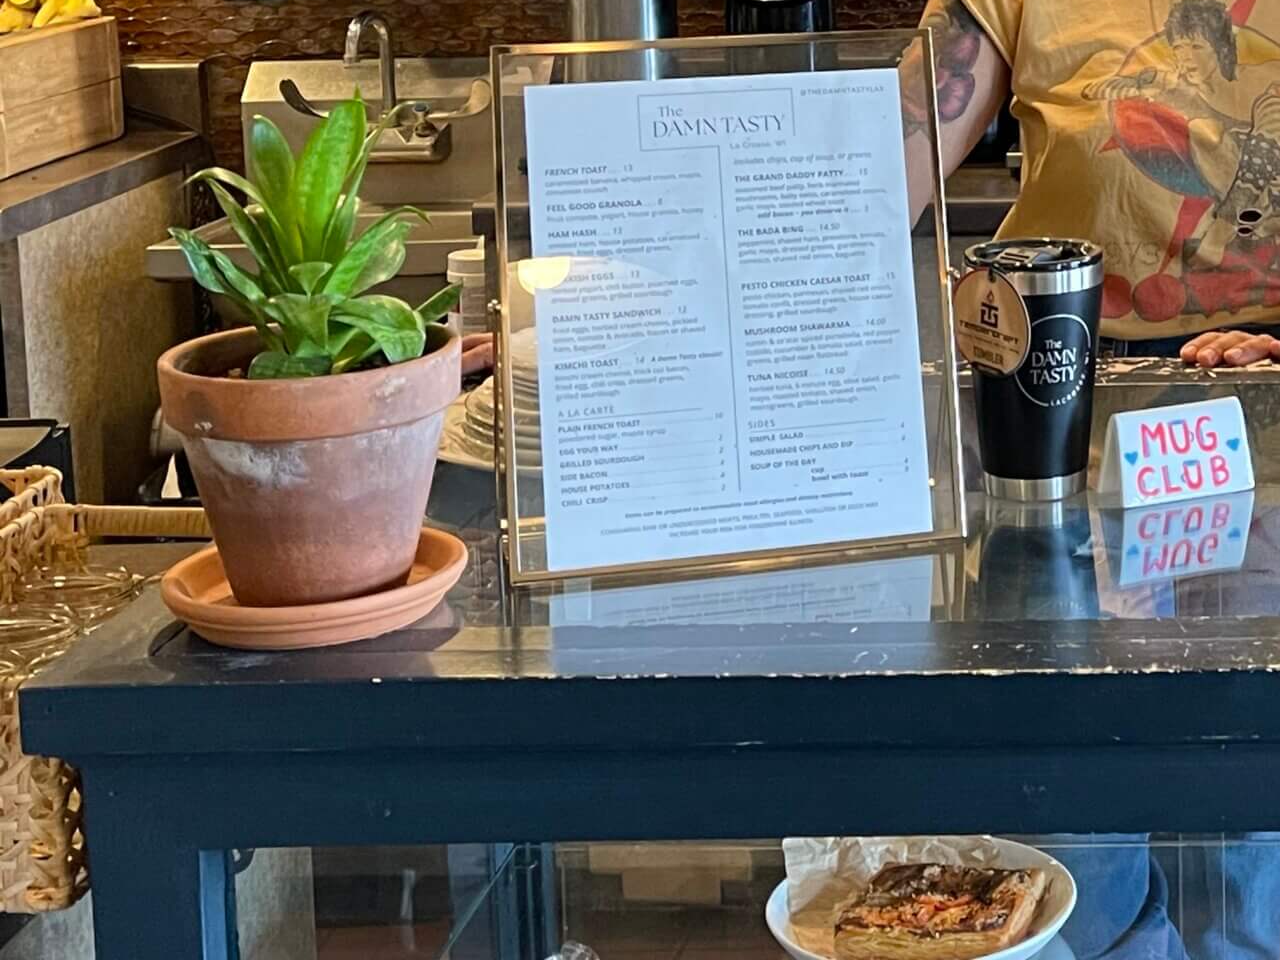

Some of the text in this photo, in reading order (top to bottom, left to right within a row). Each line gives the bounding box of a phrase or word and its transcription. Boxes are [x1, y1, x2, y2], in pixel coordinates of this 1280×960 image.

[656, 104, 684, 118] The
[652, 113, 785, 138] DAMN TASTY
[544, 167, 578, 176] FRENCH
[581, 165, 607, 174] TOAST
[734, 174, 750, 183] THE
[752, 172, 783, 182] GRAND
[785, 170, 815, 180] DADDY
[817, 169, 844, 178] PATTY
[546, 203, 566, 212] FEEL
[568, 202, 596, 210] GOOD
[598, 199, 642, 209] GRANOLA
[547, 228, 596, 239] HAM HASH
[737, 228, 753, 236] THE
[755, 226, 780, 235] BADA
[782, 225, 804, 233] BING
[591, 272, 614, 281] EGGS
[740, 281, 768, 290] PESTO
[769, 278, 807, 288] CHICKEN
[809, 275, 841, 285] CAESAR
[843, 273, 870, 283] TOAST
[551, 313, 581, 323] DAMN
[583, 311, 610, 320] TASTY
[612, 307, 661, 318] SANDWICH
[744, 324, 797, 335] MUSHROOM
[799, 320, 850, 331] SHAWARMA
[1044, 339, 1063, 349] The
[1031, 347, 1077, 367] DAMN
[553, 360, 588, 370] KIMCHI
[590, 358, 619, 368] TOAST
[746, 372, 772, 382] TUNA
[1029, 364, 1077, 384] TASTY
[567, 408, 579, 417] LA
[583, 405, 614, 415] CARTE
[557, 424, 581, 433] PLAIN
[583, 421, 614, 431] FRENCH
[616, 419, 640, 428] TOAST
[747, 418, 775, 429] SIDES
[779, 431, 803, 440] SALAD
[1139, 415, 1218, 458] MUG
[559, 447, 574, 456] EGG
[600, 444, 618, 452] WAY
[749, 445, 797, 456] HOUSEMADE
[798, 443, 820, 452] CHIPS
[822, 441, 839, 450] AND
[559, 458, 591, 468] GRILLED
[750, 462, 771, 470] SOUP
[784, 459, 798, 467] THE
[800, 457, 816, 466] DAY
[579, 470, 607, 479] BACON
[1136, 455, 1230, 497] CLUB
[589, 481, 630, 492] POTATOES
[585, 495, 608, 505] CRISP
